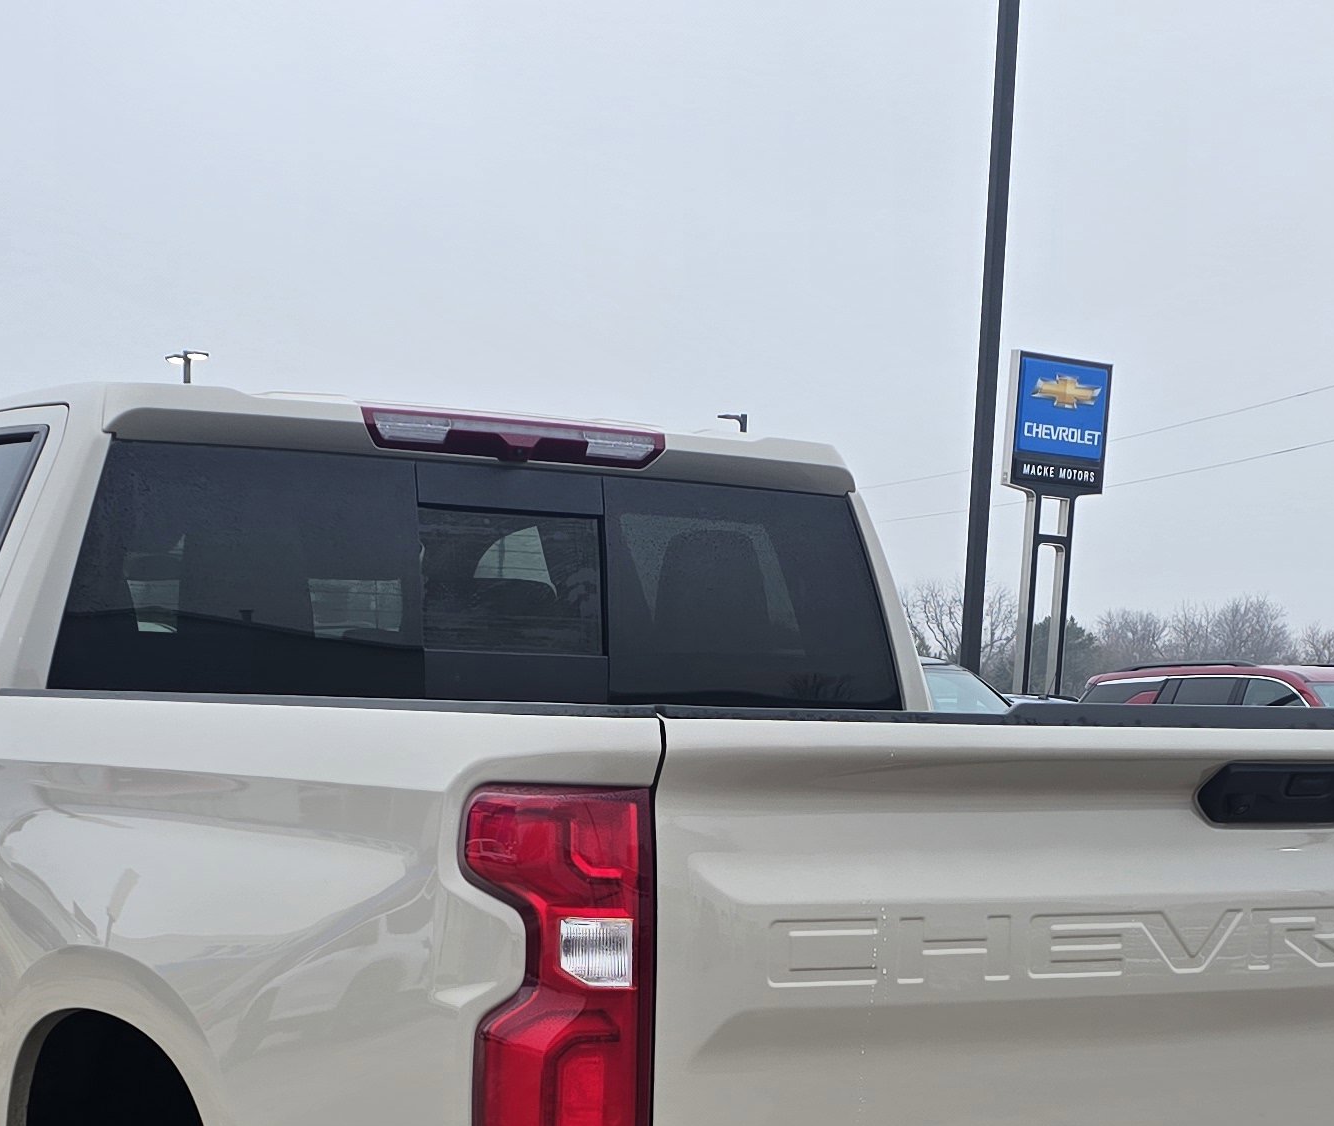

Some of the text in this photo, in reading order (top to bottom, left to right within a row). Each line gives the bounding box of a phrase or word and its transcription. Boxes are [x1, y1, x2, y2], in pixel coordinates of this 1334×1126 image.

[1024, 421, 1101, 446] CHEVROLET
[1022, 463, 1095, 483] MACKE MOTORS
